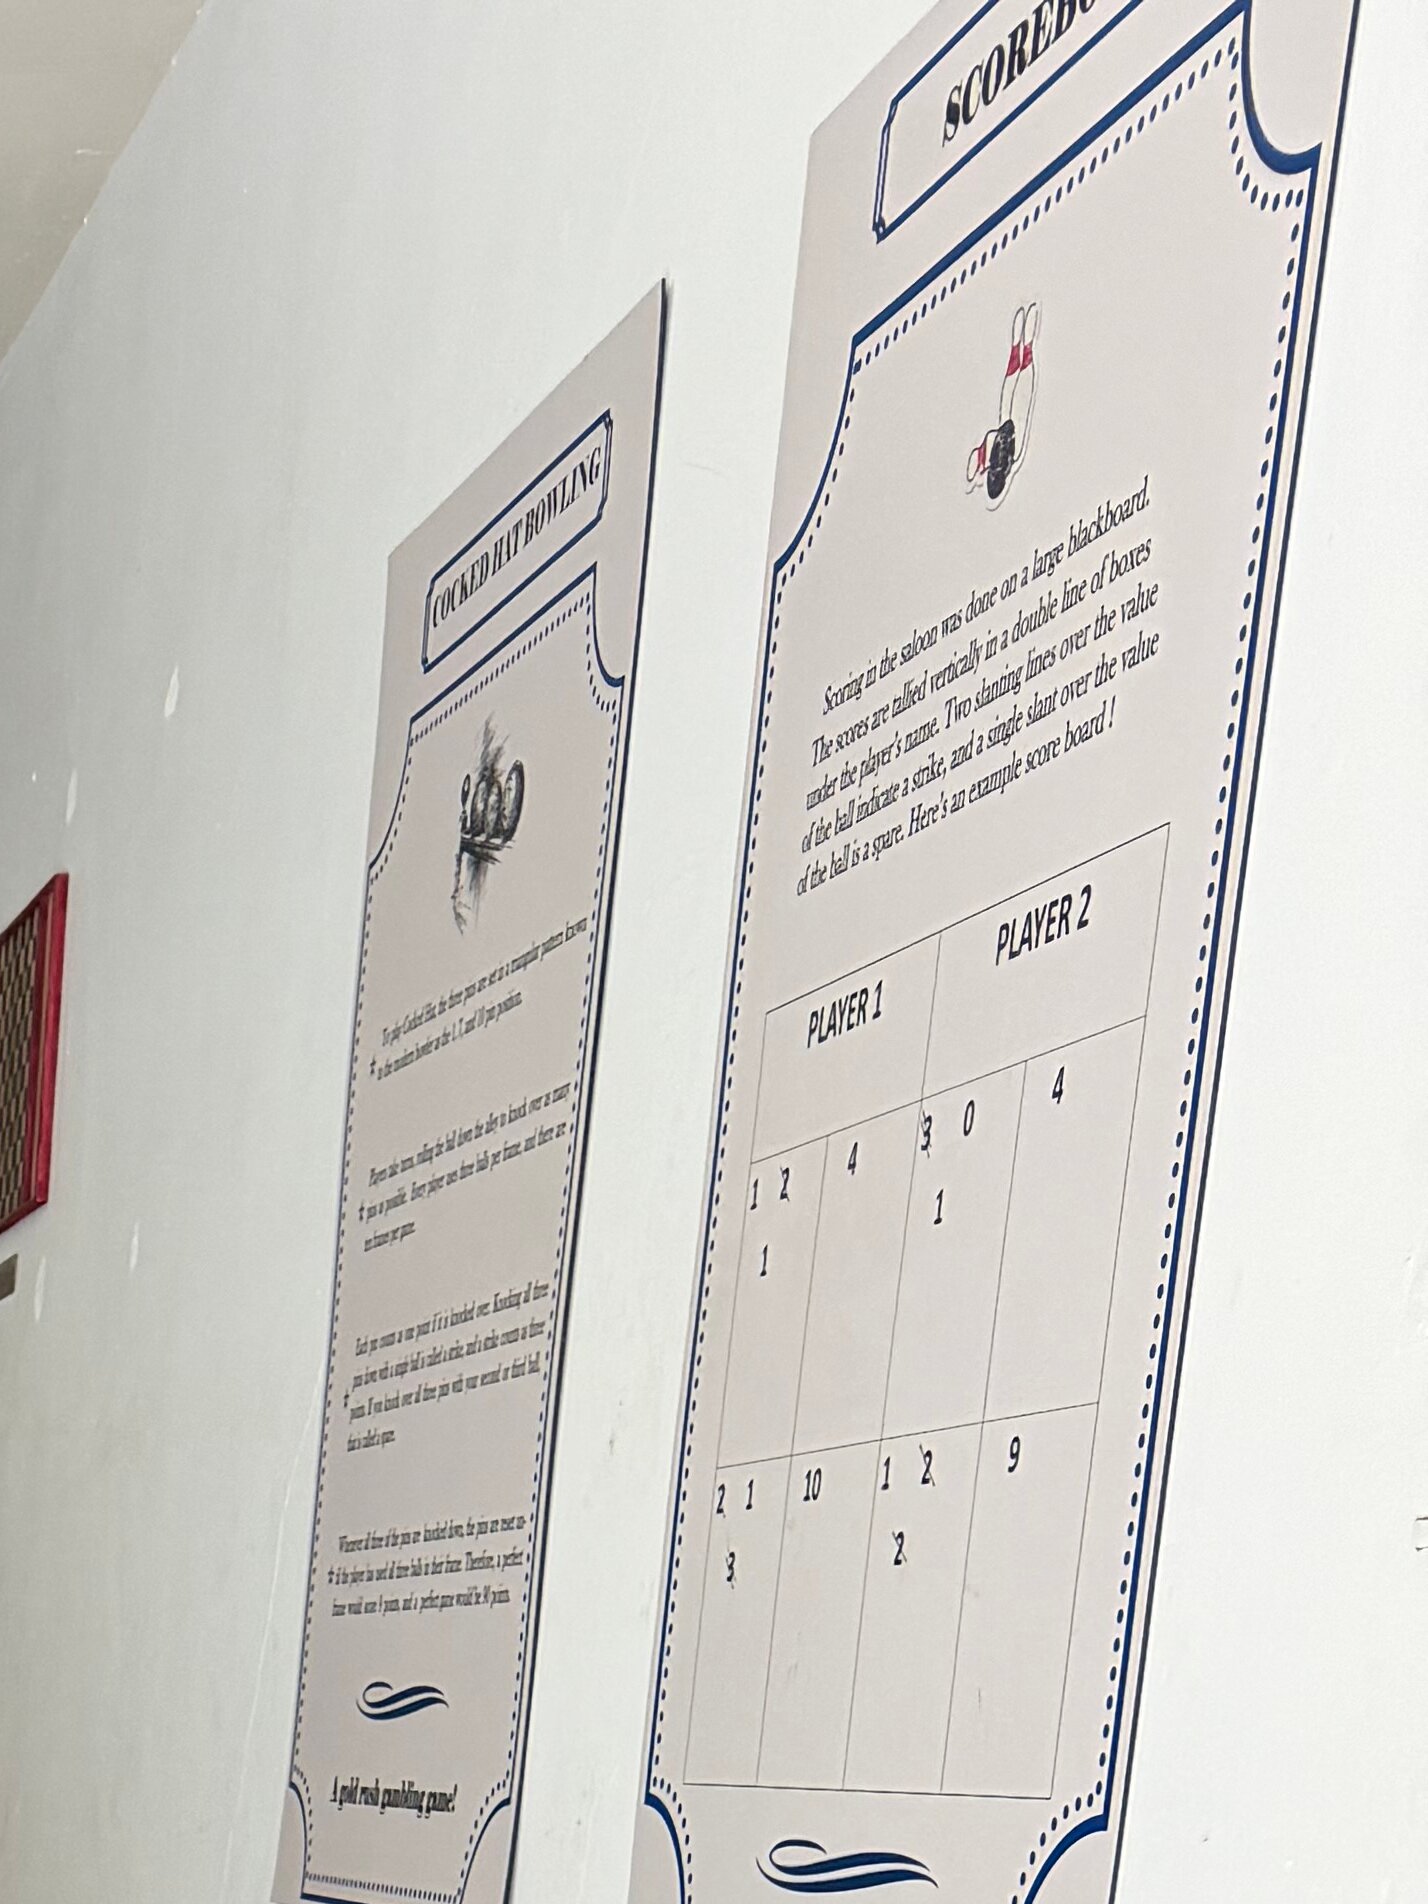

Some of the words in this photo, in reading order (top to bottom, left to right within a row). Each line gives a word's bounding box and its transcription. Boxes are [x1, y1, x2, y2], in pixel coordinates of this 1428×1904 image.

[432, 552, 490, 628] COCKED
[491, 518, 523, 576] HAT
[523, 447, 601, 547] BOWLING
[822, 672, 865, 716] Scoring
[864, 659, 877, 689] in
[879, 647, 898, 680] the
[899, 626, 938, 666] saloon
[941, 609, 963, 638] was
[965, 586, 998, 623] done
[1000, 573, 1018, 601] on
[1020, 566, 1029, 589] a
[1031, 542, 1064, 581] large
[1067, 475, 1149, 557] blackboard.
[811, 735, 834, 768] The
[835, 716, 870, 753] scores
[870, 703, 890, 731] are
[891, 669, 928, 718] tallied
[930, 638, 983, 693] vertically
[984, 629, 998, 662] in
[1000, 629, 1009, 651] a
[1011, 590, 1058, 644] double
[1060, 577, 1087, 614] line
[1090, 553, 1110, 595] of
[1109, 538, 1152, 584] boxes
[839, 760, 858, 792] the
[858, 731, 902, 788] player's
[903, 717, 940, 754] name.
[944, 696, 972, 729] Two
[974, 664, 1024, 712] slanting
[1024, 645, 1057, 683] lines
[1059, 624, 1091, 660] over
[1093, 604, 1117, 641] the
[1121, 582, 1159, 624] value
[796, 864, 811, 897] of
[810, 859, 828, 890] the
[829, 843, 851, 880] ball
[850, 839, 861, 868] is
[862, 841, 870, 862] a
[871, 824, 905, 862] spare.
[907, 791, 948, 837] Here's
[949, 789, 966, 814] an
[968, 750, 1022, 804] example
[1024, 737, 1061, 774] score
[1064, 700, 1107, 753] board
[801, 821, 817, 854] of
[814, 816, 832, 847] the
[834, 798, 856, 836] ball
[901, 777, 909, 798] a
[911, 752, 947, 792] strike,
[949, 728, 975, 771] and
[975, 734, 984, 756] a
[986, 704, 1024, 749] single
[1025, 687, 1058, 727] slant
[1060, 671, 1093, 707] over
[1094, 652, 1118, 688] the
[1121, 630, 1160, 672] value
[994, 897, 1070, 966] PLAYER
[1076, 884, 1093, 931] 2
[807, 986, 869, 1049] PLAYER
[872, 979, 884, 1020] 1
[750, 1179, 759, 1211] 1
[847, 1142, 858, 1175] 4
[963, 1100, 975, 1137] 0
[1051, 1066, 1065, 1105] 4
[760, 1244, 769, 1277] 1
[933, 1188, 944, 1225] 1
[716, 1484, 726, 1515] 2
[745, 1479, 754, 1510] 1
[802, 1467, 822, 1502] 10
[880, 1456, 891, 1491] 1
[1007, 1436, 1021, 1473] 9
[329, 1775, 339, 1803] A
[337, 1776, 360, 1811] gold
[358, 1777, 381, 1807] rush
[380, 1780, 426, 1819] gambling
[424, 1784, 458, 1819] game!
